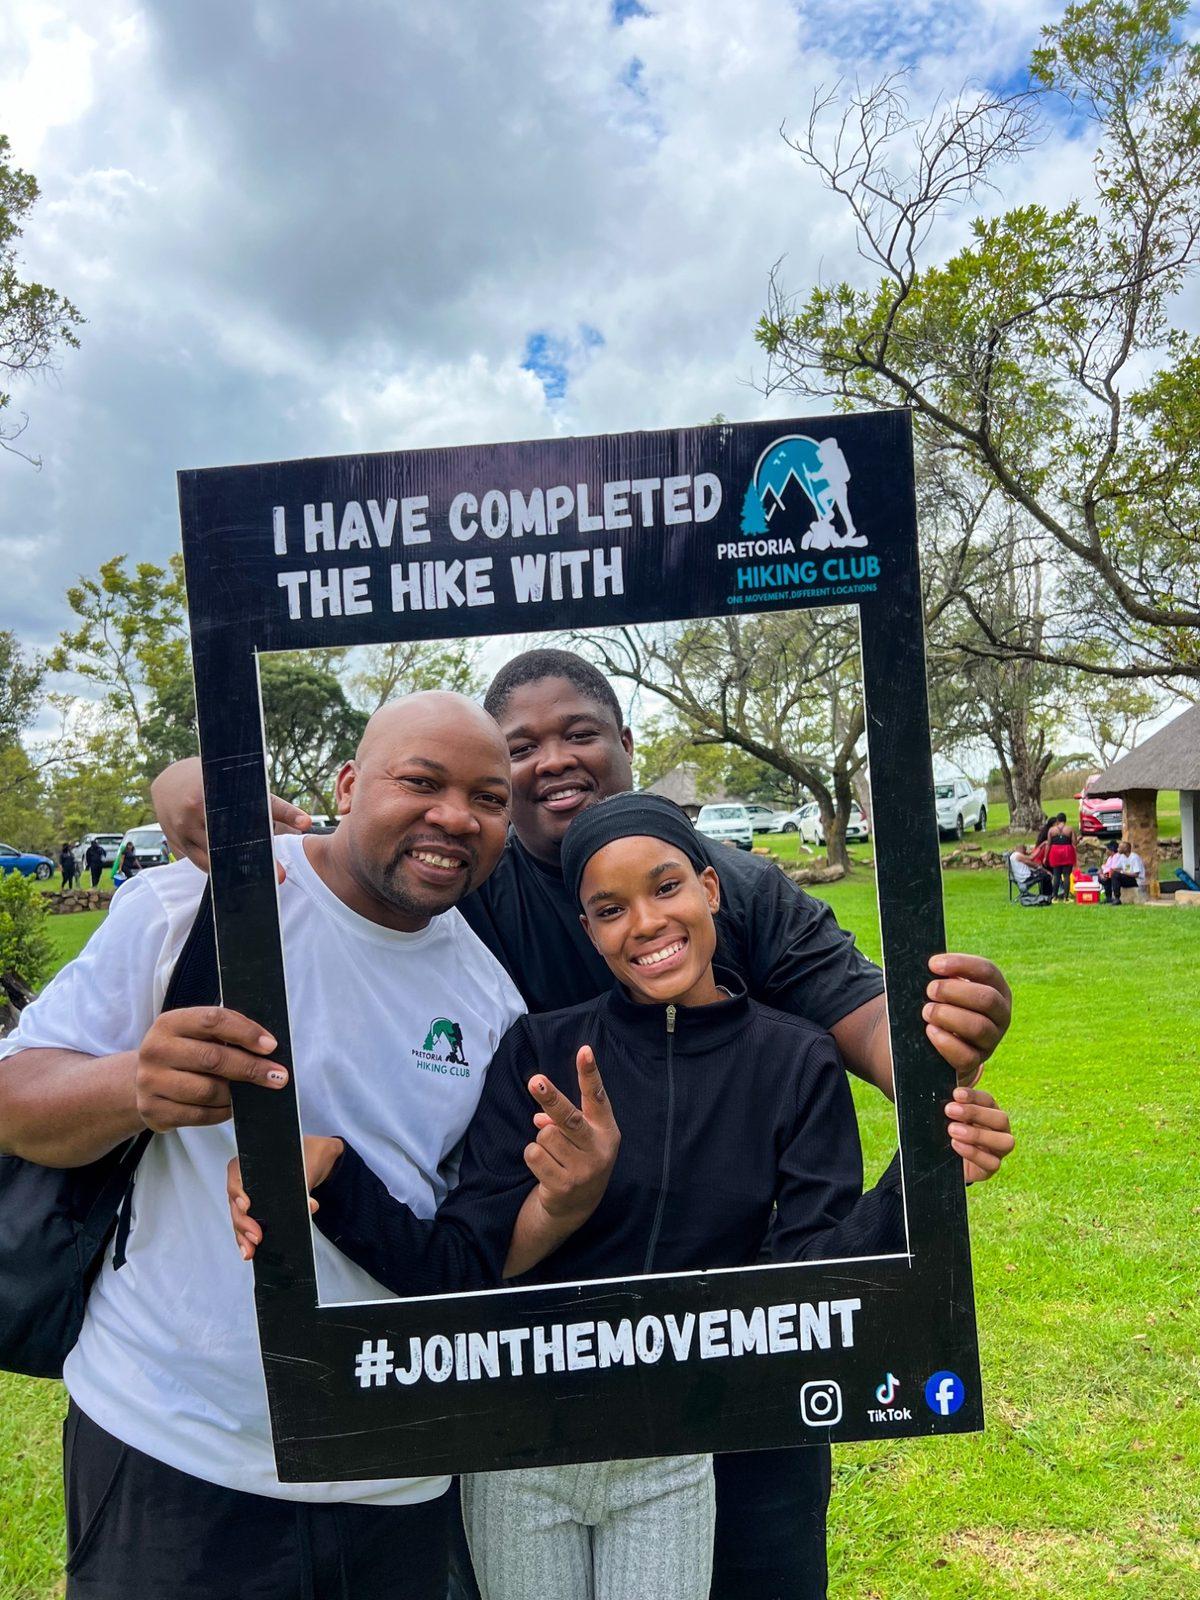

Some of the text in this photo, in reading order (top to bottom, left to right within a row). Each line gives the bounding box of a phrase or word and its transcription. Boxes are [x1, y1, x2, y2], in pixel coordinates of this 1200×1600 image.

[273, 472, 722, 555] I HAVE COMPLETED
[717, 538, 795, 559] PRETORIA
[737, 555, 880, 589] HIKING CLUB
[277, 547, 624, 620] THE HIKE WITH
[727, 595, 743, 605] ONE
[832, 583, 878, 595] LOCATIONS
[411, 1049, 442, 1062] PRETORIA
[417, 1060, 470, 1078] HIKING CLUB
[355, 1298, 862, 1388] #JOINTHEMOVEMENT
[867, 1407, 912, 1422] TikTok
